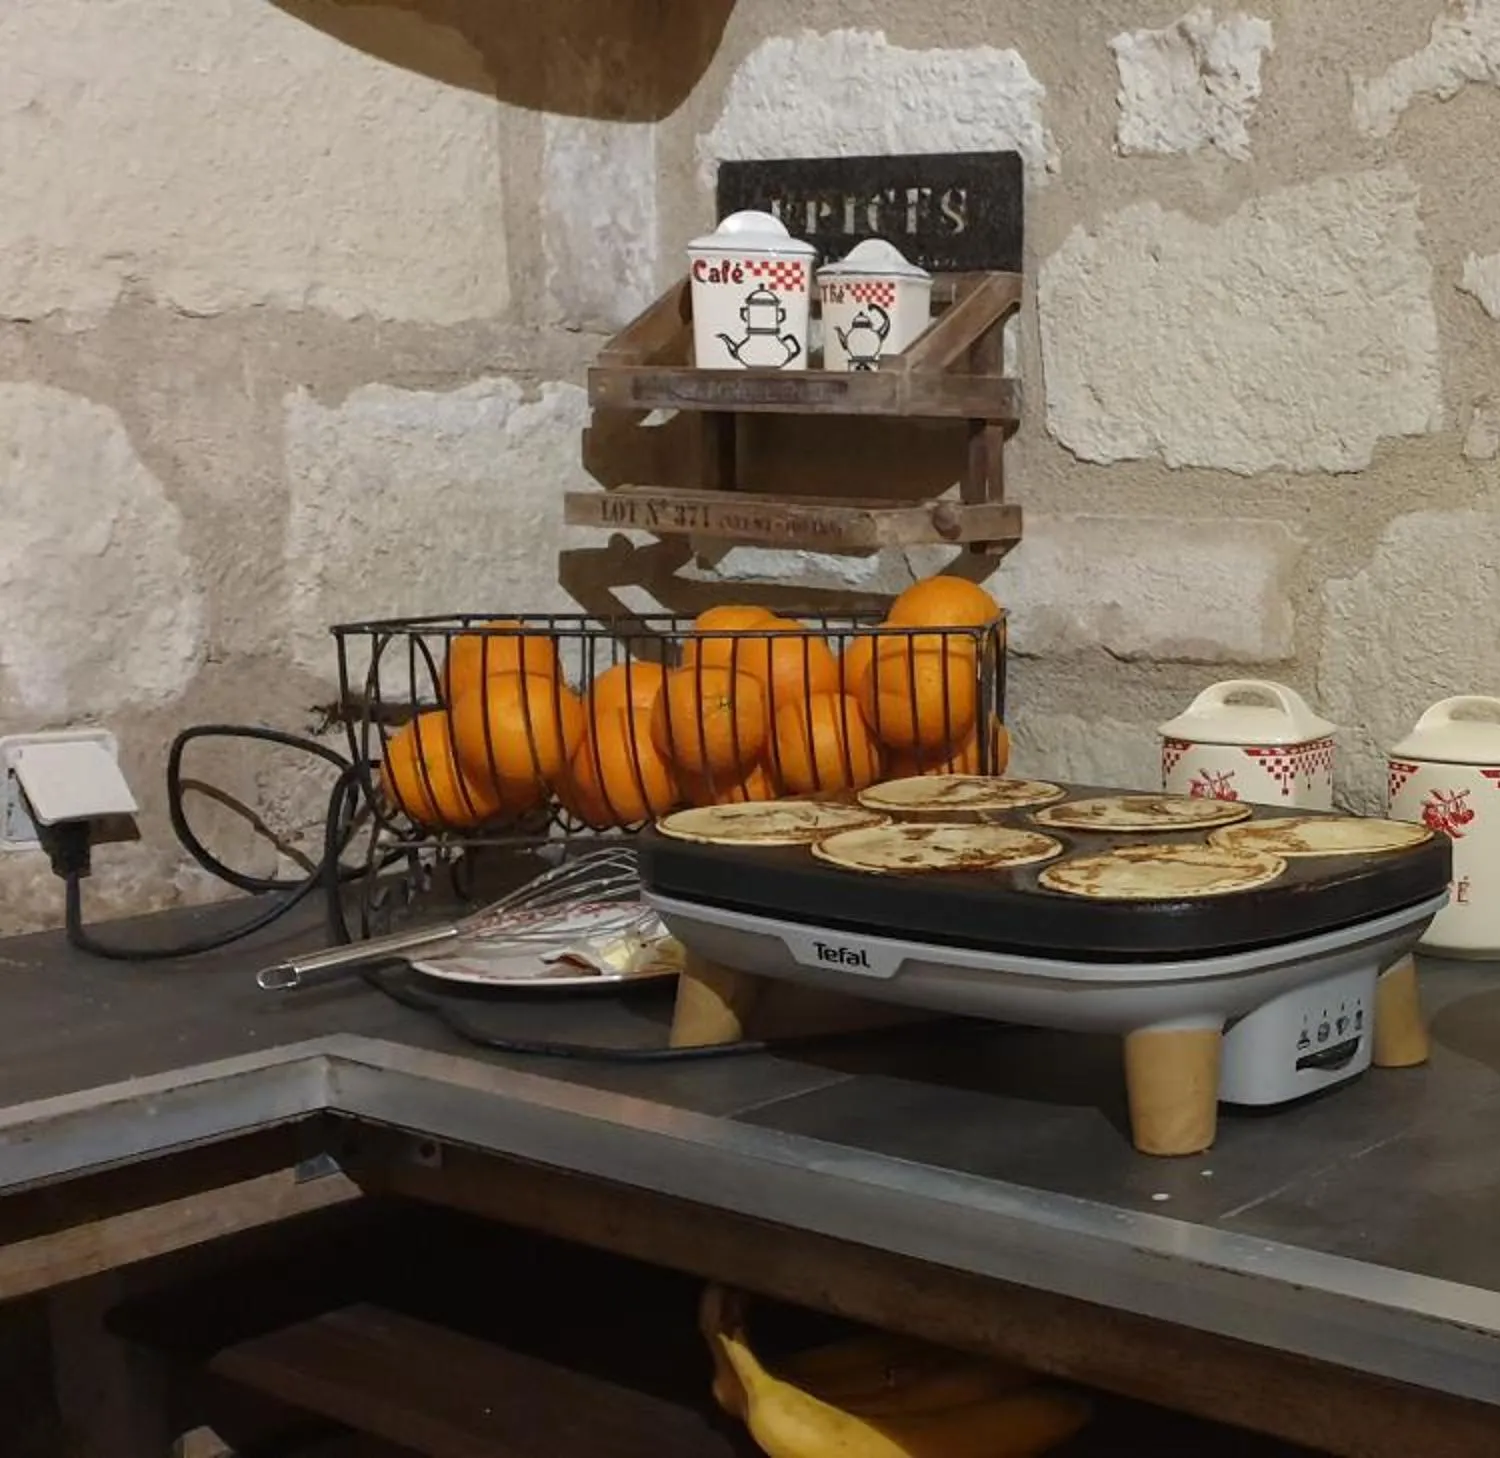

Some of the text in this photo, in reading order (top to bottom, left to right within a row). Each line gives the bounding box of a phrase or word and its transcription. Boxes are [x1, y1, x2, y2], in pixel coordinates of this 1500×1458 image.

[692, 260, 744, 284] Café
[821, 282, 845, 304] Thé
[602, 497, 637, 524] LOT
[675, 504, 710, 528] 371
[813, 942, 870, 968] Tefal
